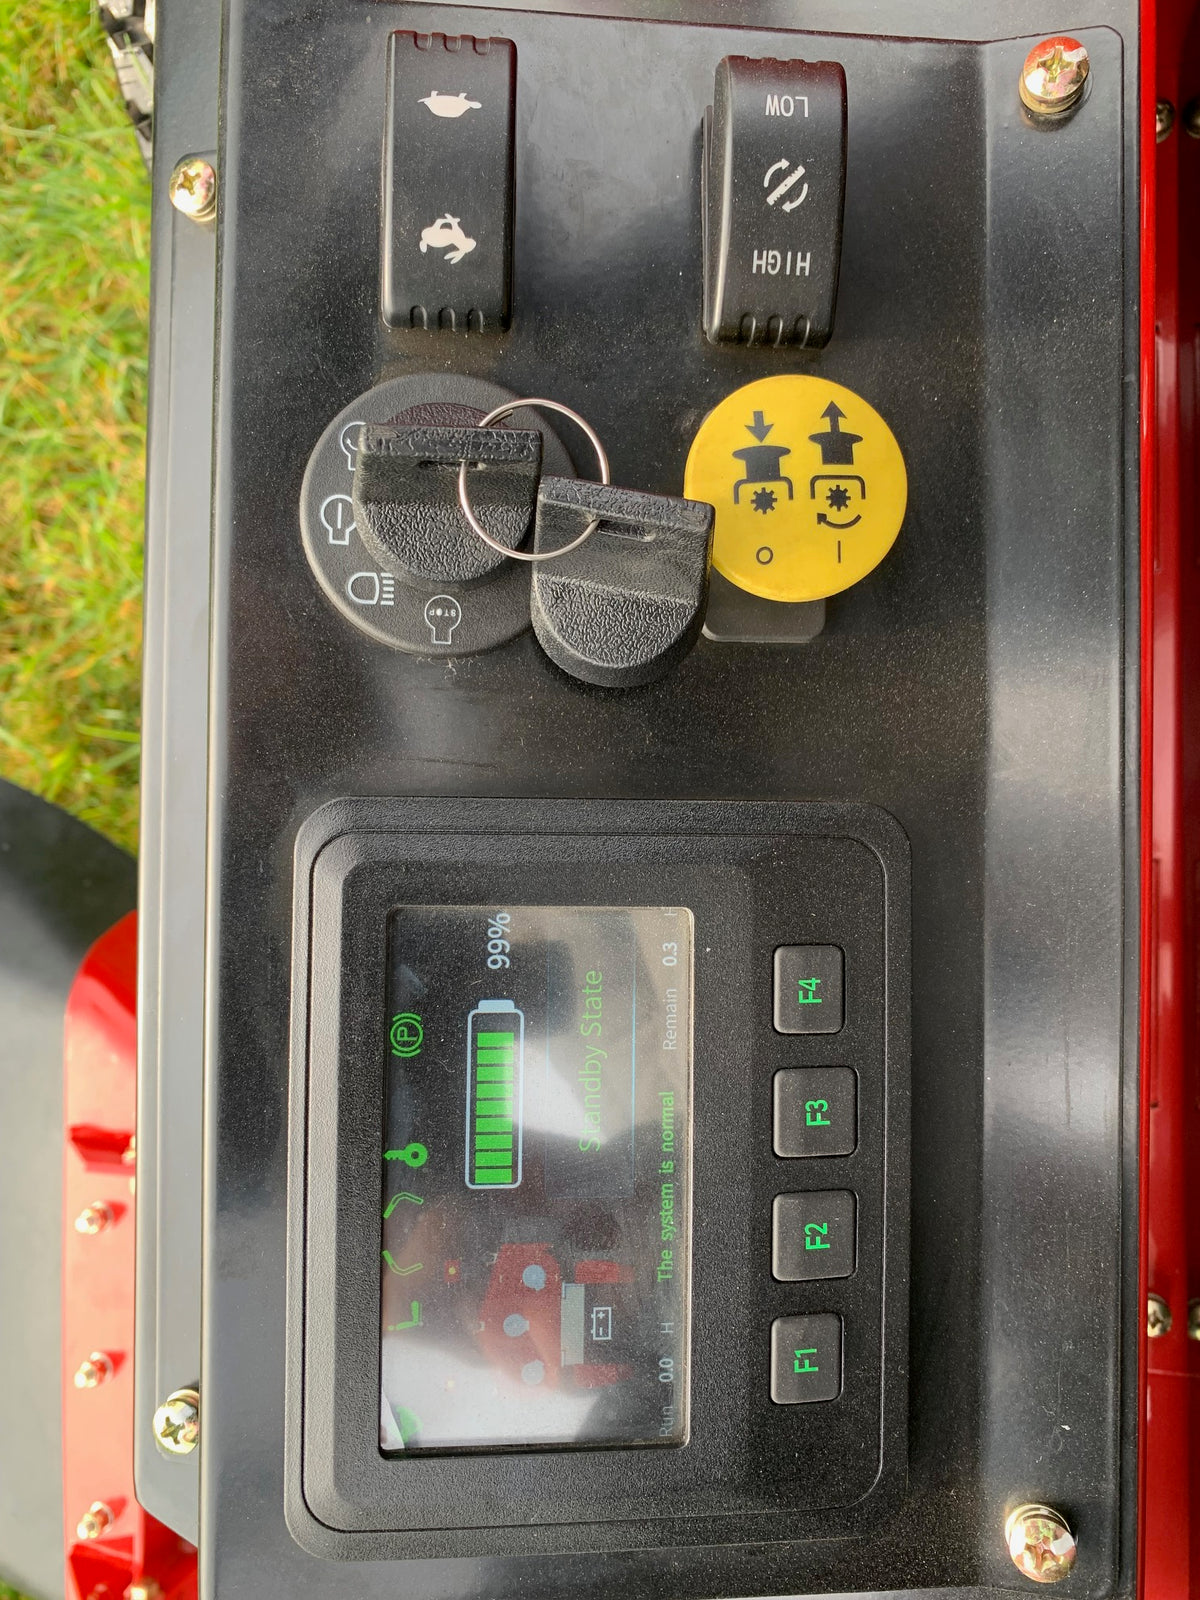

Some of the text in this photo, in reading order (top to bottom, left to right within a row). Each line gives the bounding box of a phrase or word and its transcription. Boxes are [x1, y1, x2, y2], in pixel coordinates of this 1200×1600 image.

[765, 94, 808, 117] LOW
[752, 249, 811, 276] HIGH
[487, 913, 512, 970] 99%
[662, 942, 678, 966] 0.3
[798, 977, 822, 1004] F4
[662, 988, 678, 1050] Remain
[579, 970, 607, 1151] Standby State
[805, 1099, 830, 1126] F3
[657, 1091, 677, 1281] The system is normal
[805, 1222, 830, 1250] F2
[794, 1348, 819, 1373] F1
[659, 1322, 675, 1437] Run 0.0 H
